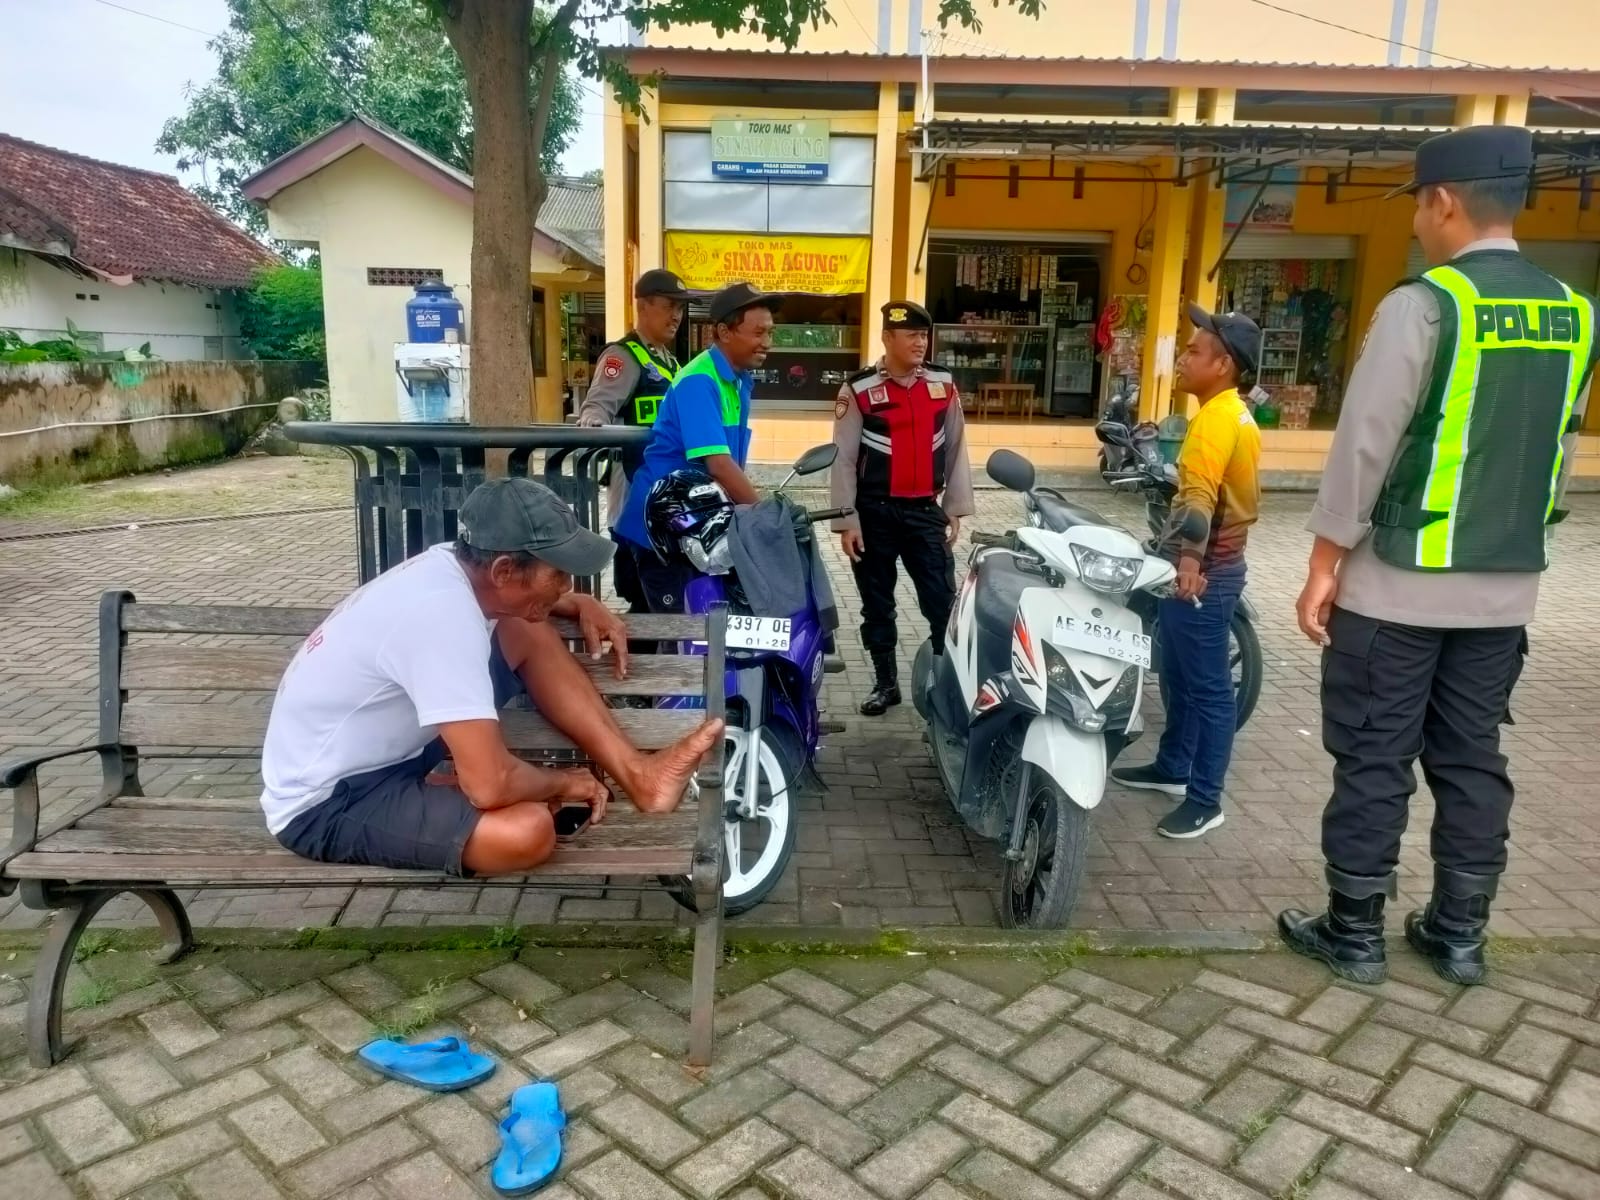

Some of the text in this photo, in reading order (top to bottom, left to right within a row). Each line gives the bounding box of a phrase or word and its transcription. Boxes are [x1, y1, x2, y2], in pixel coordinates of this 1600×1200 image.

[748, 122, 792, 134] TOKO MAS
[714, 136, 825, 159] SINAR AGUNG
[737, 240, 793, 250] TOKO MAS
[1473, 304, 1580, 343] POLISI
[1055, 616, 1075, 631] AE
[1132, 634, 1150, 651] GS
